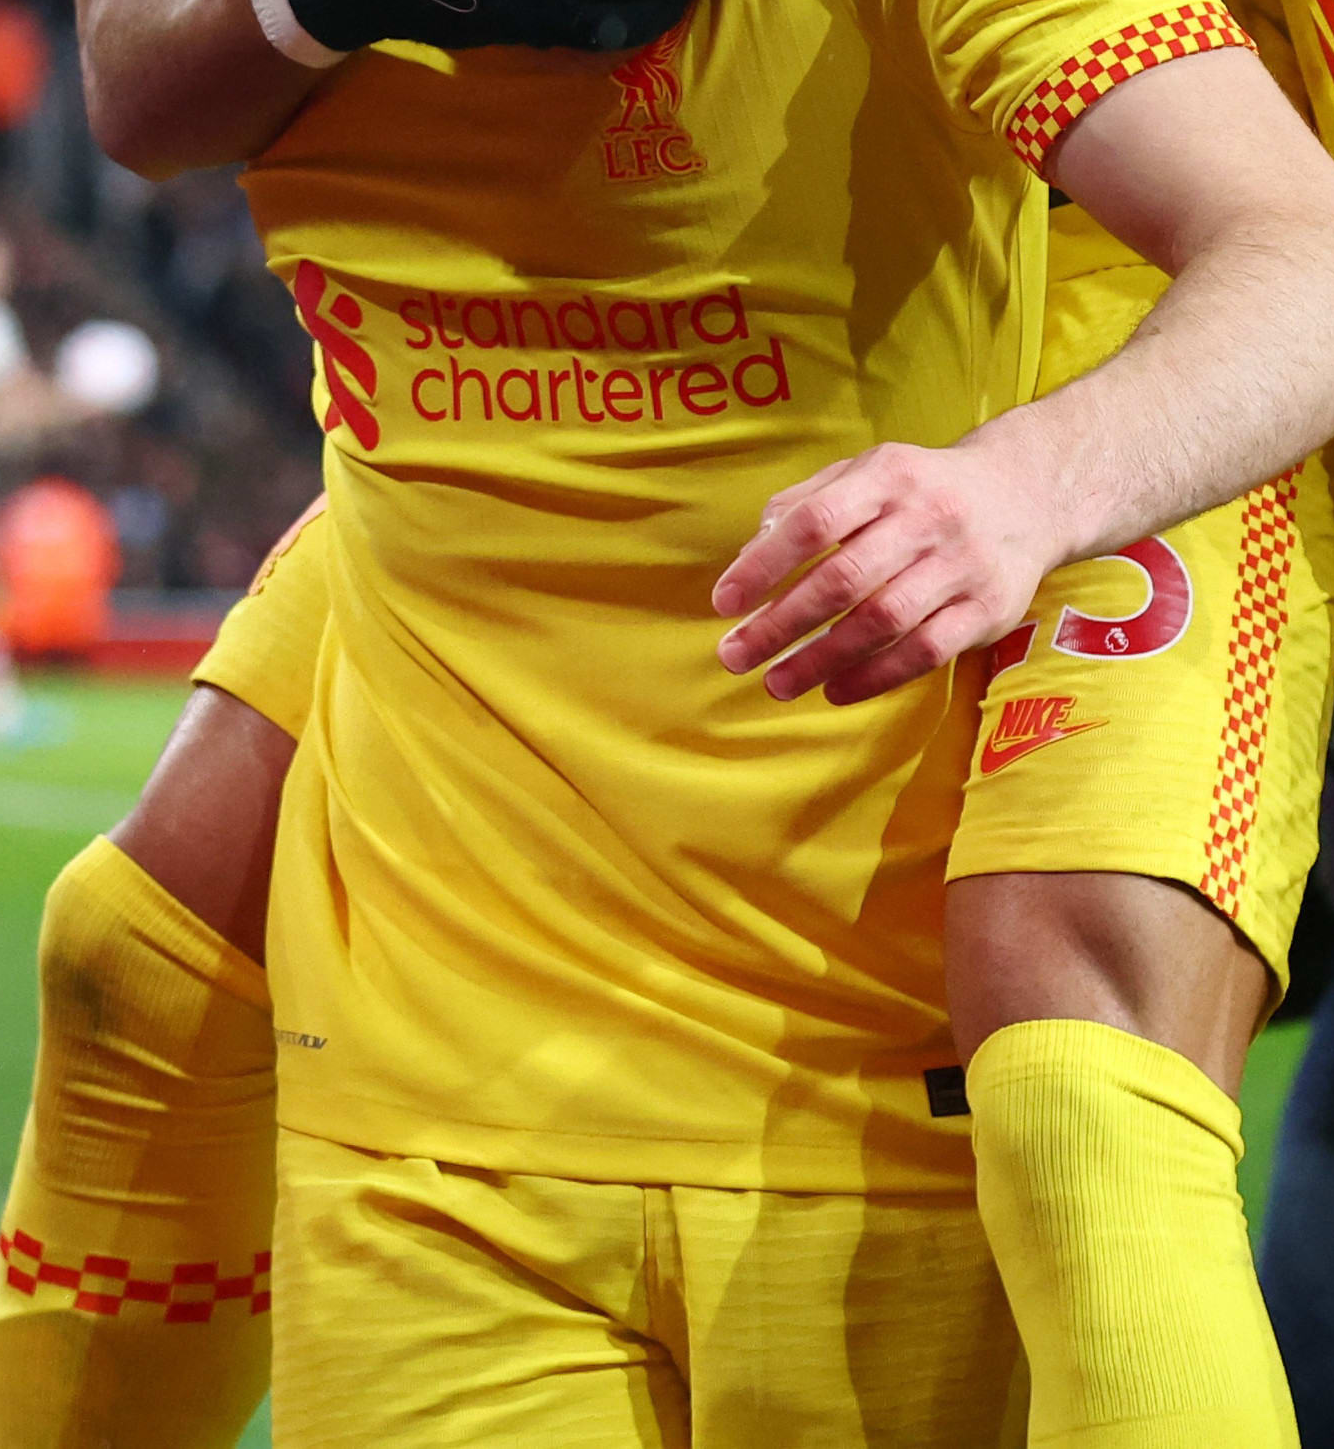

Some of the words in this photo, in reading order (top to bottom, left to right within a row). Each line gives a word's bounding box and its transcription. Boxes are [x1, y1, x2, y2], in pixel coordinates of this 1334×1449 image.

[398, 285, 751, 351] standard
[410, 337, 792, 423] chartered
[994, 697, 1076, 740] NIKE
